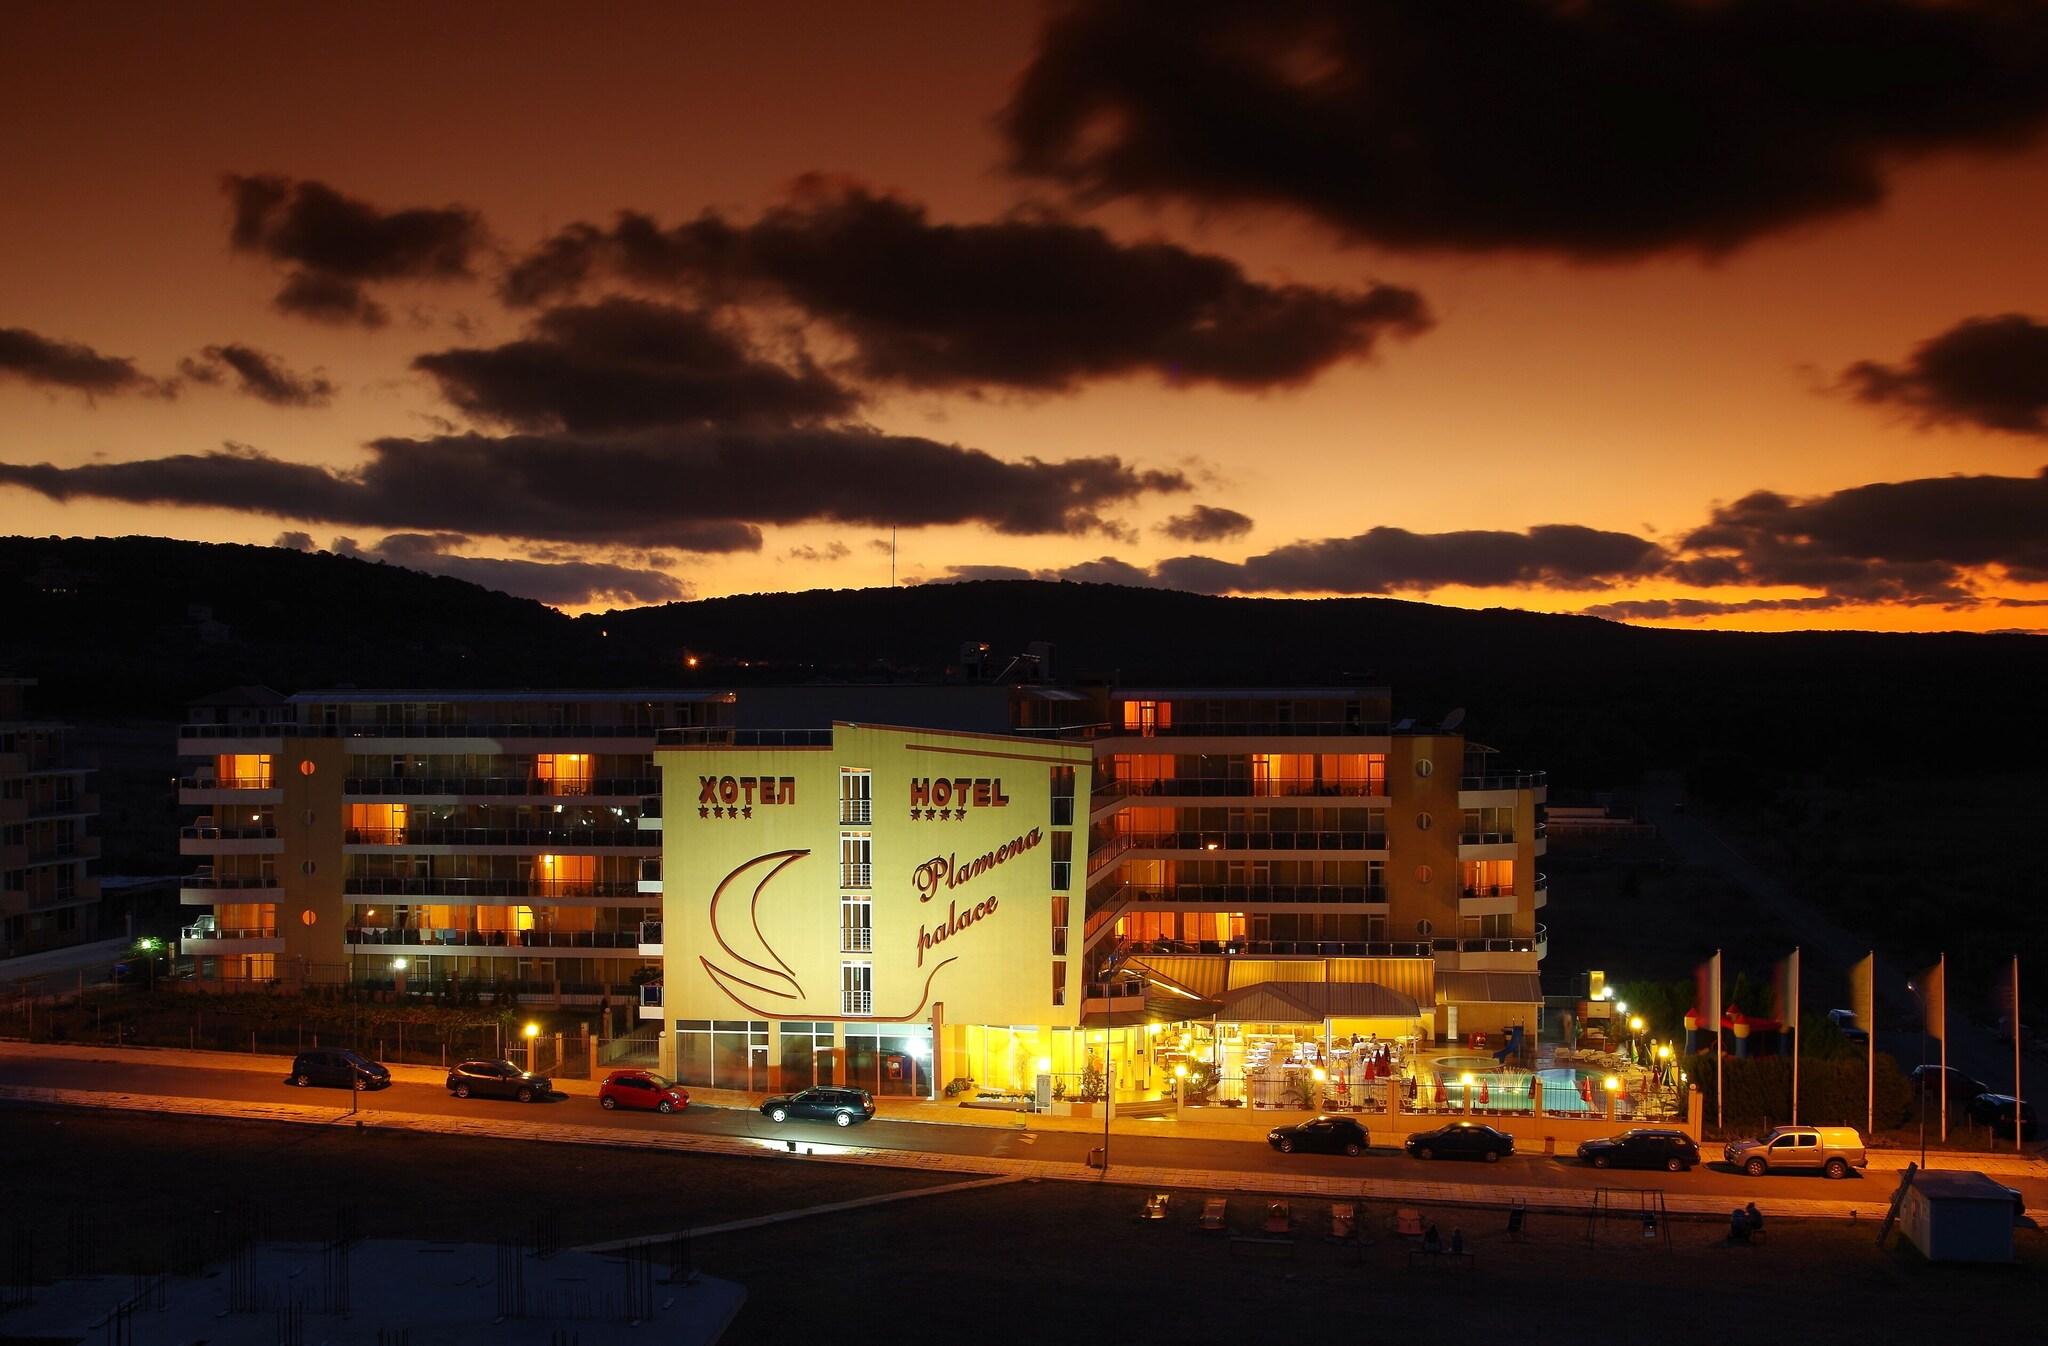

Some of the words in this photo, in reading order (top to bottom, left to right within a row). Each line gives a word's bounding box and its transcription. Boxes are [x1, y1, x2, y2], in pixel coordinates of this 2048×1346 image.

[699, 776, 795, 805] ХОТЕЛ
[910, 778, 1010, 807] HOTEL
[912, 825, 1043, 902] Plamena
[917, 895, 999, 967] palace
